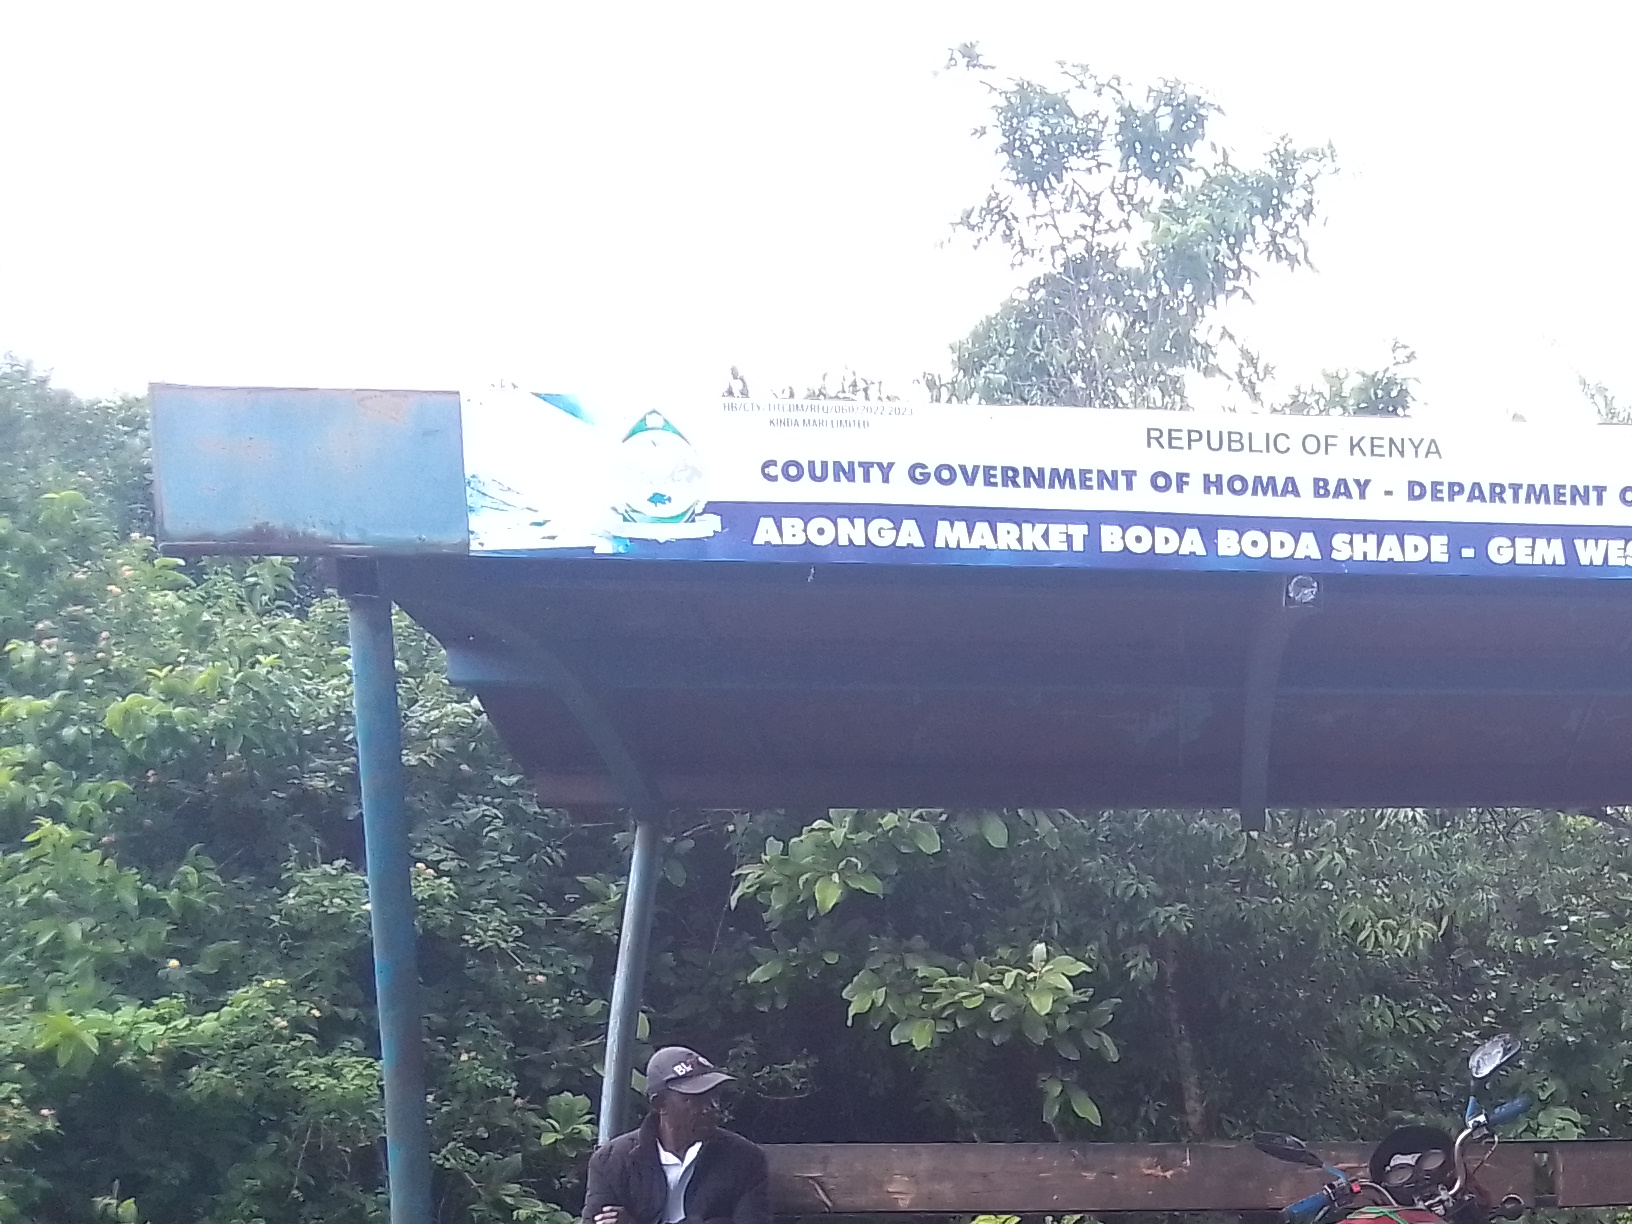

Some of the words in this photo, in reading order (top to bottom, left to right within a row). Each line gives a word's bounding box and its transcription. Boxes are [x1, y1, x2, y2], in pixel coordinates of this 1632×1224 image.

[1146, 427, 1291, 455] REPUBLIC
[1301, 433, 1338, 456] OF
[1349, 435, 1443, 459] KENYA
[760, 459, 896, 485] COUNTY
[907, 462, 1138, 492] GOVERNMENT
[1149, 470, 1191, 494] OF
[1202, 473, 1302, 499] HOMA
[1312, 476, 1372, 501] BAY
[1407, 479, 1608, 507] DEPARTMENT
[752, 516, 926, 548] ABONGA
[934, 520, 1089, 552] MARKET
[1100, 524, 1207, 556] BODA
[1217, 529, 1322, 560] BODA
[1330, 532, 1449, 563] SHADE
[1487, 536, 1566, 565] GEM
